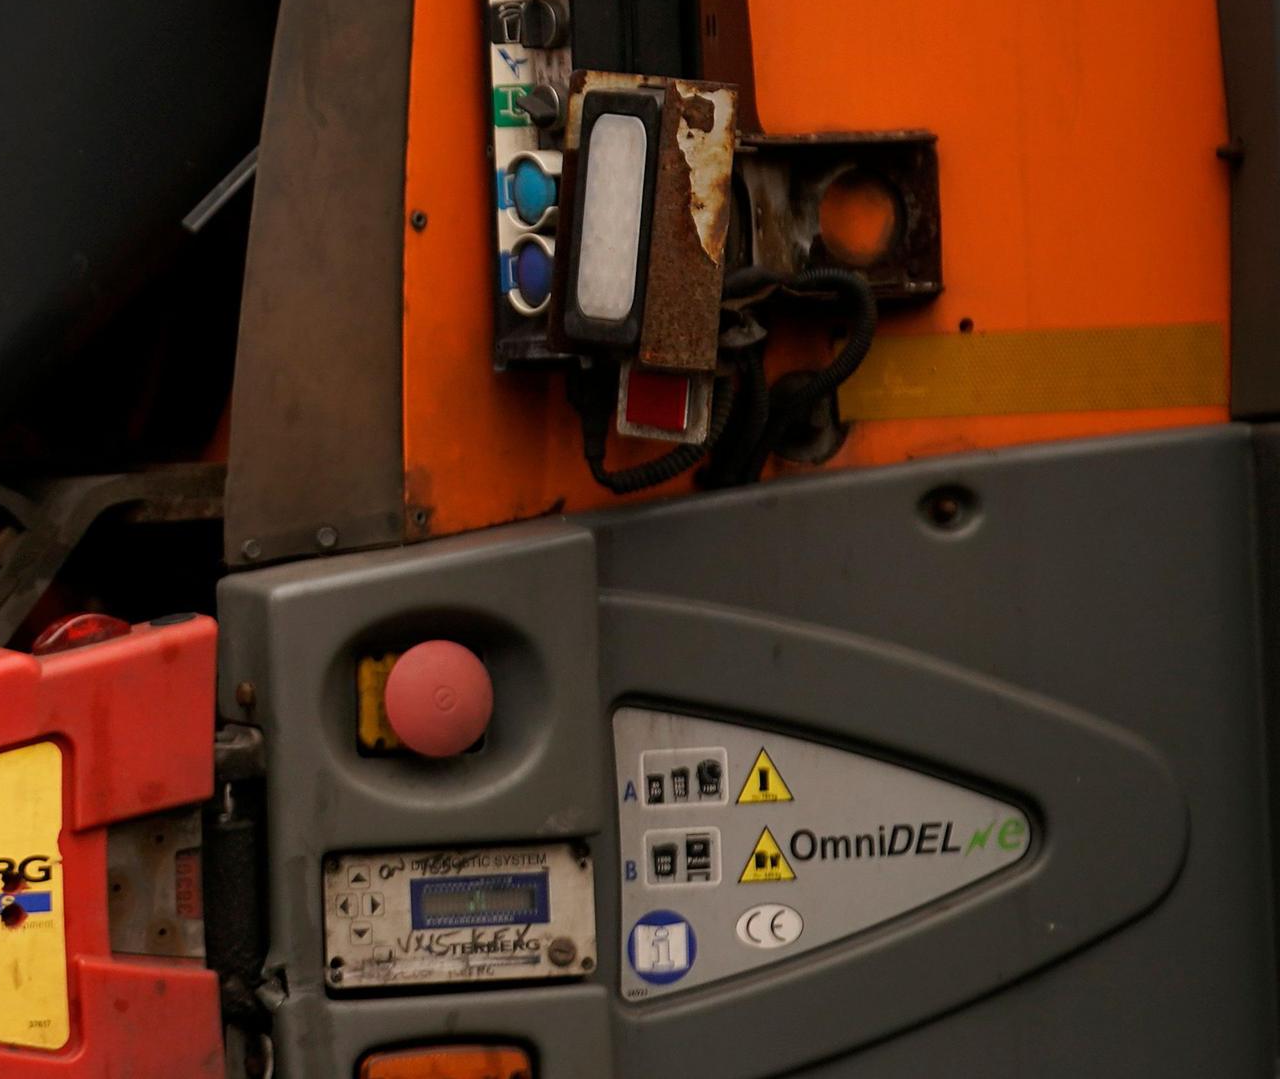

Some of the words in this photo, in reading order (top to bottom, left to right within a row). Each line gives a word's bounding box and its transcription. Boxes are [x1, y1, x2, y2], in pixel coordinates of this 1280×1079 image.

[624, 781, 638, 801] A
[494, 853, 546, 867] SYSTEM
[625, 863, 637, 881] B
